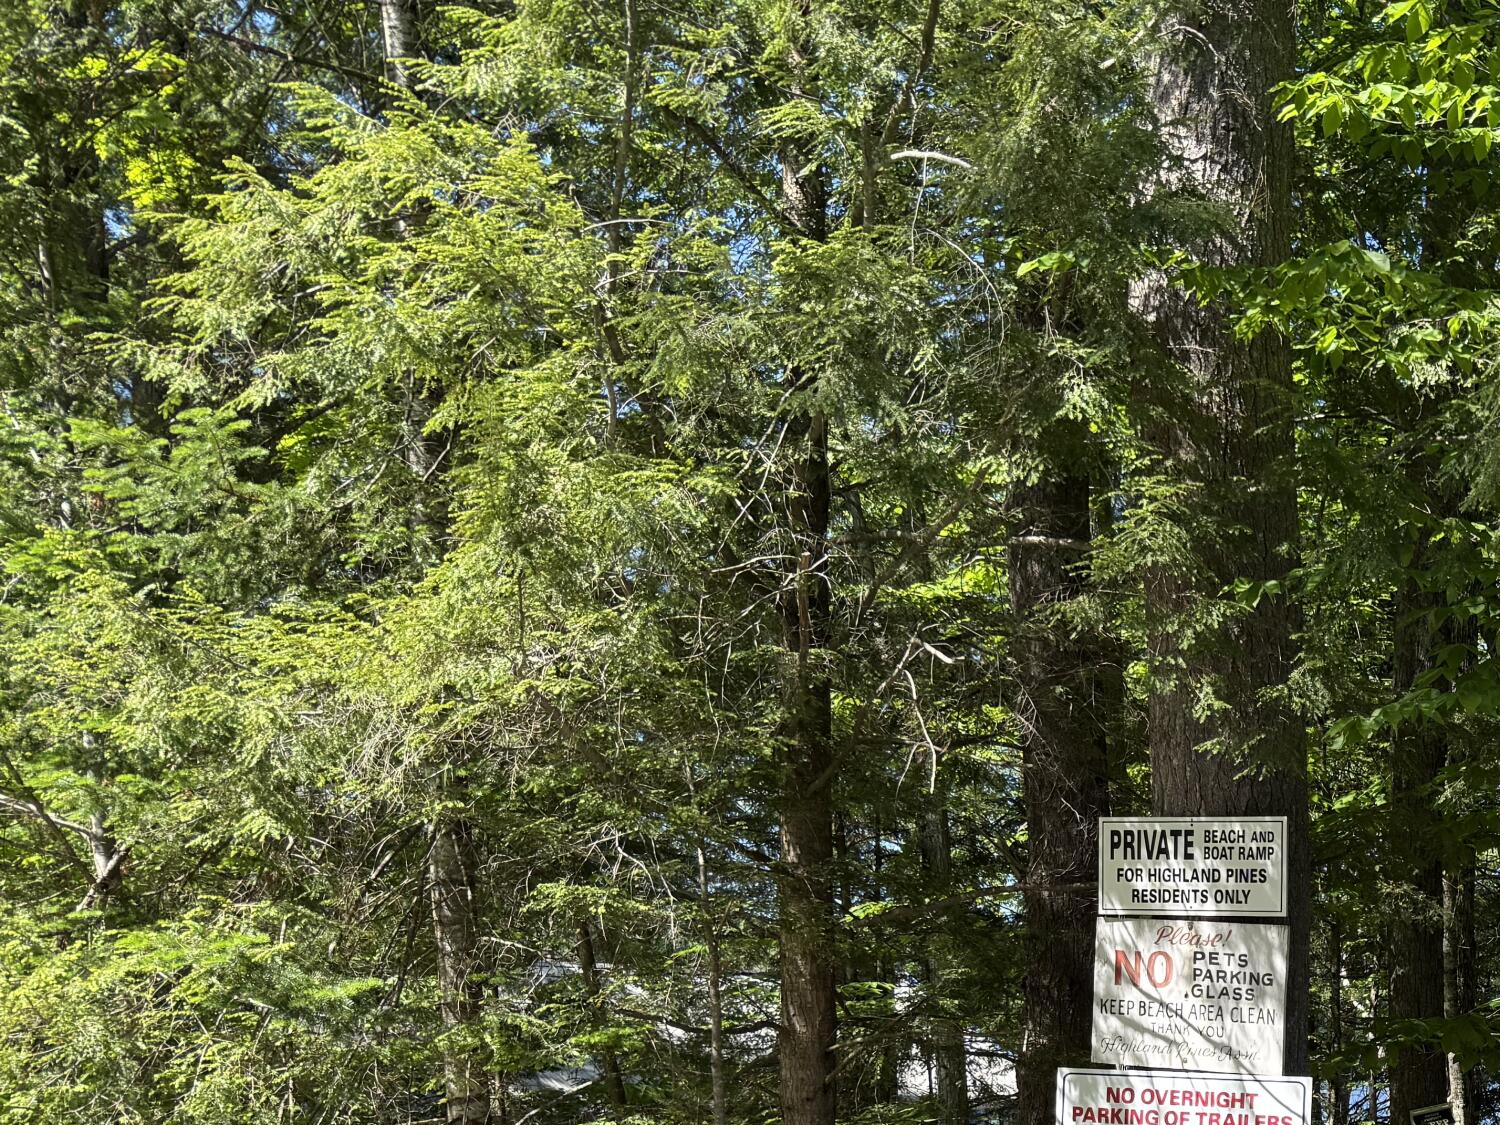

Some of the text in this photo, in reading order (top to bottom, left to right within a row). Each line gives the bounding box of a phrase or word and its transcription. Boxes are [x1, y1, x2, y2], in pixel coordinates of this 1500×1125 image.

[1109, 829, 1195, 861] PRIVATE
[1203, 830, 1275, 844] BEACH AND
[1203, 846, 1275, 861] BOAT RAMP
[1116, 868, 1267, 883] FOR HIGHLAND PINES
[1131, 888, 1251, 905] RESIDENTS ONLY
[1154, 925, 1232, 947] Please!
[1114, 949, 1174, 988] NO
[1193, 951, 1249, 968] PETS
[1192, 968, 1274, 987] PARKING
[1191, 983, 1256, 1001] GLASS
[1100, 999, 1276, 1025] KEEP BEACH AREA CLEAN
[1151, 1022, 1224, 1038] THANK YOU
[1100, 1034, 1174, 1060] Highland
[1106, 1087, 1258, 1109] NO OVERNIGHT
[1072, 1106, 1159, 1125] PARKING
